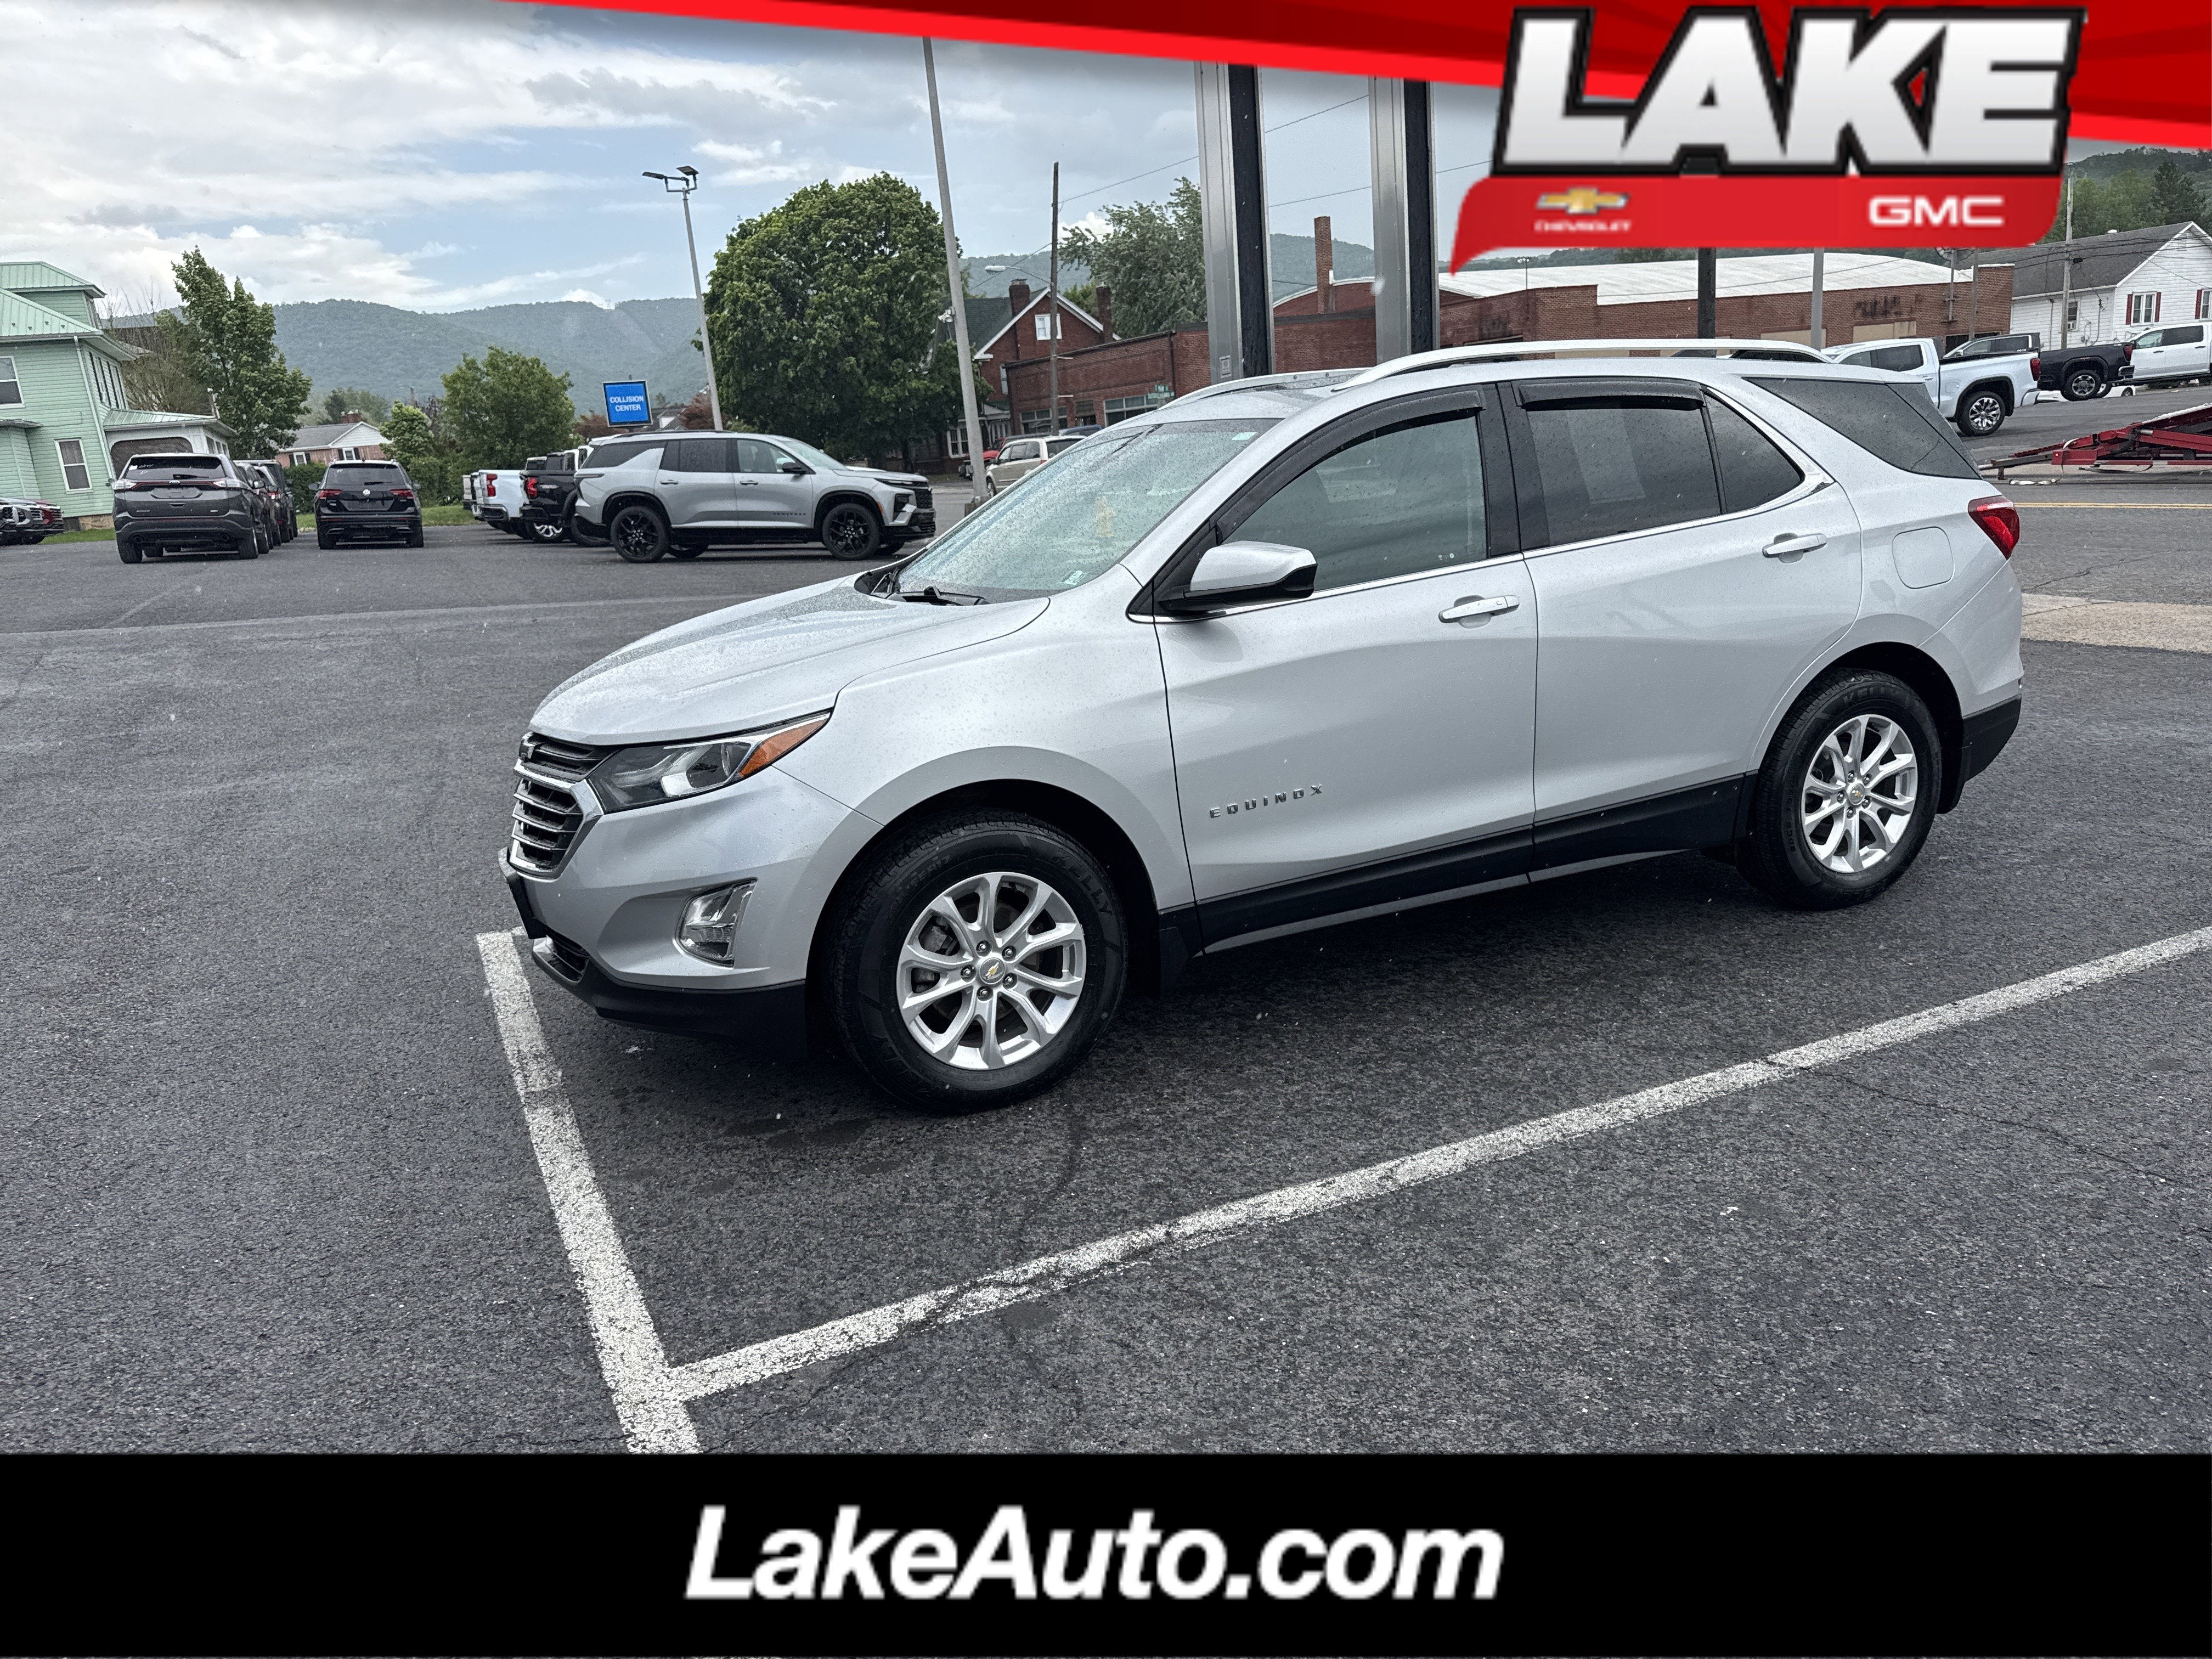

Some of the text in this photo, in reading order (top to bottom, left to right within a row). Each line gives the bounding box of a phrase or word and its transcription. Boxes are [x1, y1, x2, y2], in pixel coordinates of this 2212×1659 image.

[610, 395, 644, 404] COLLISION
[615, 404, 641, 412] CENTER
[1210, 783, 1322, 818] EQUINOX
[1052, 851, 1113, 916] KELLY
